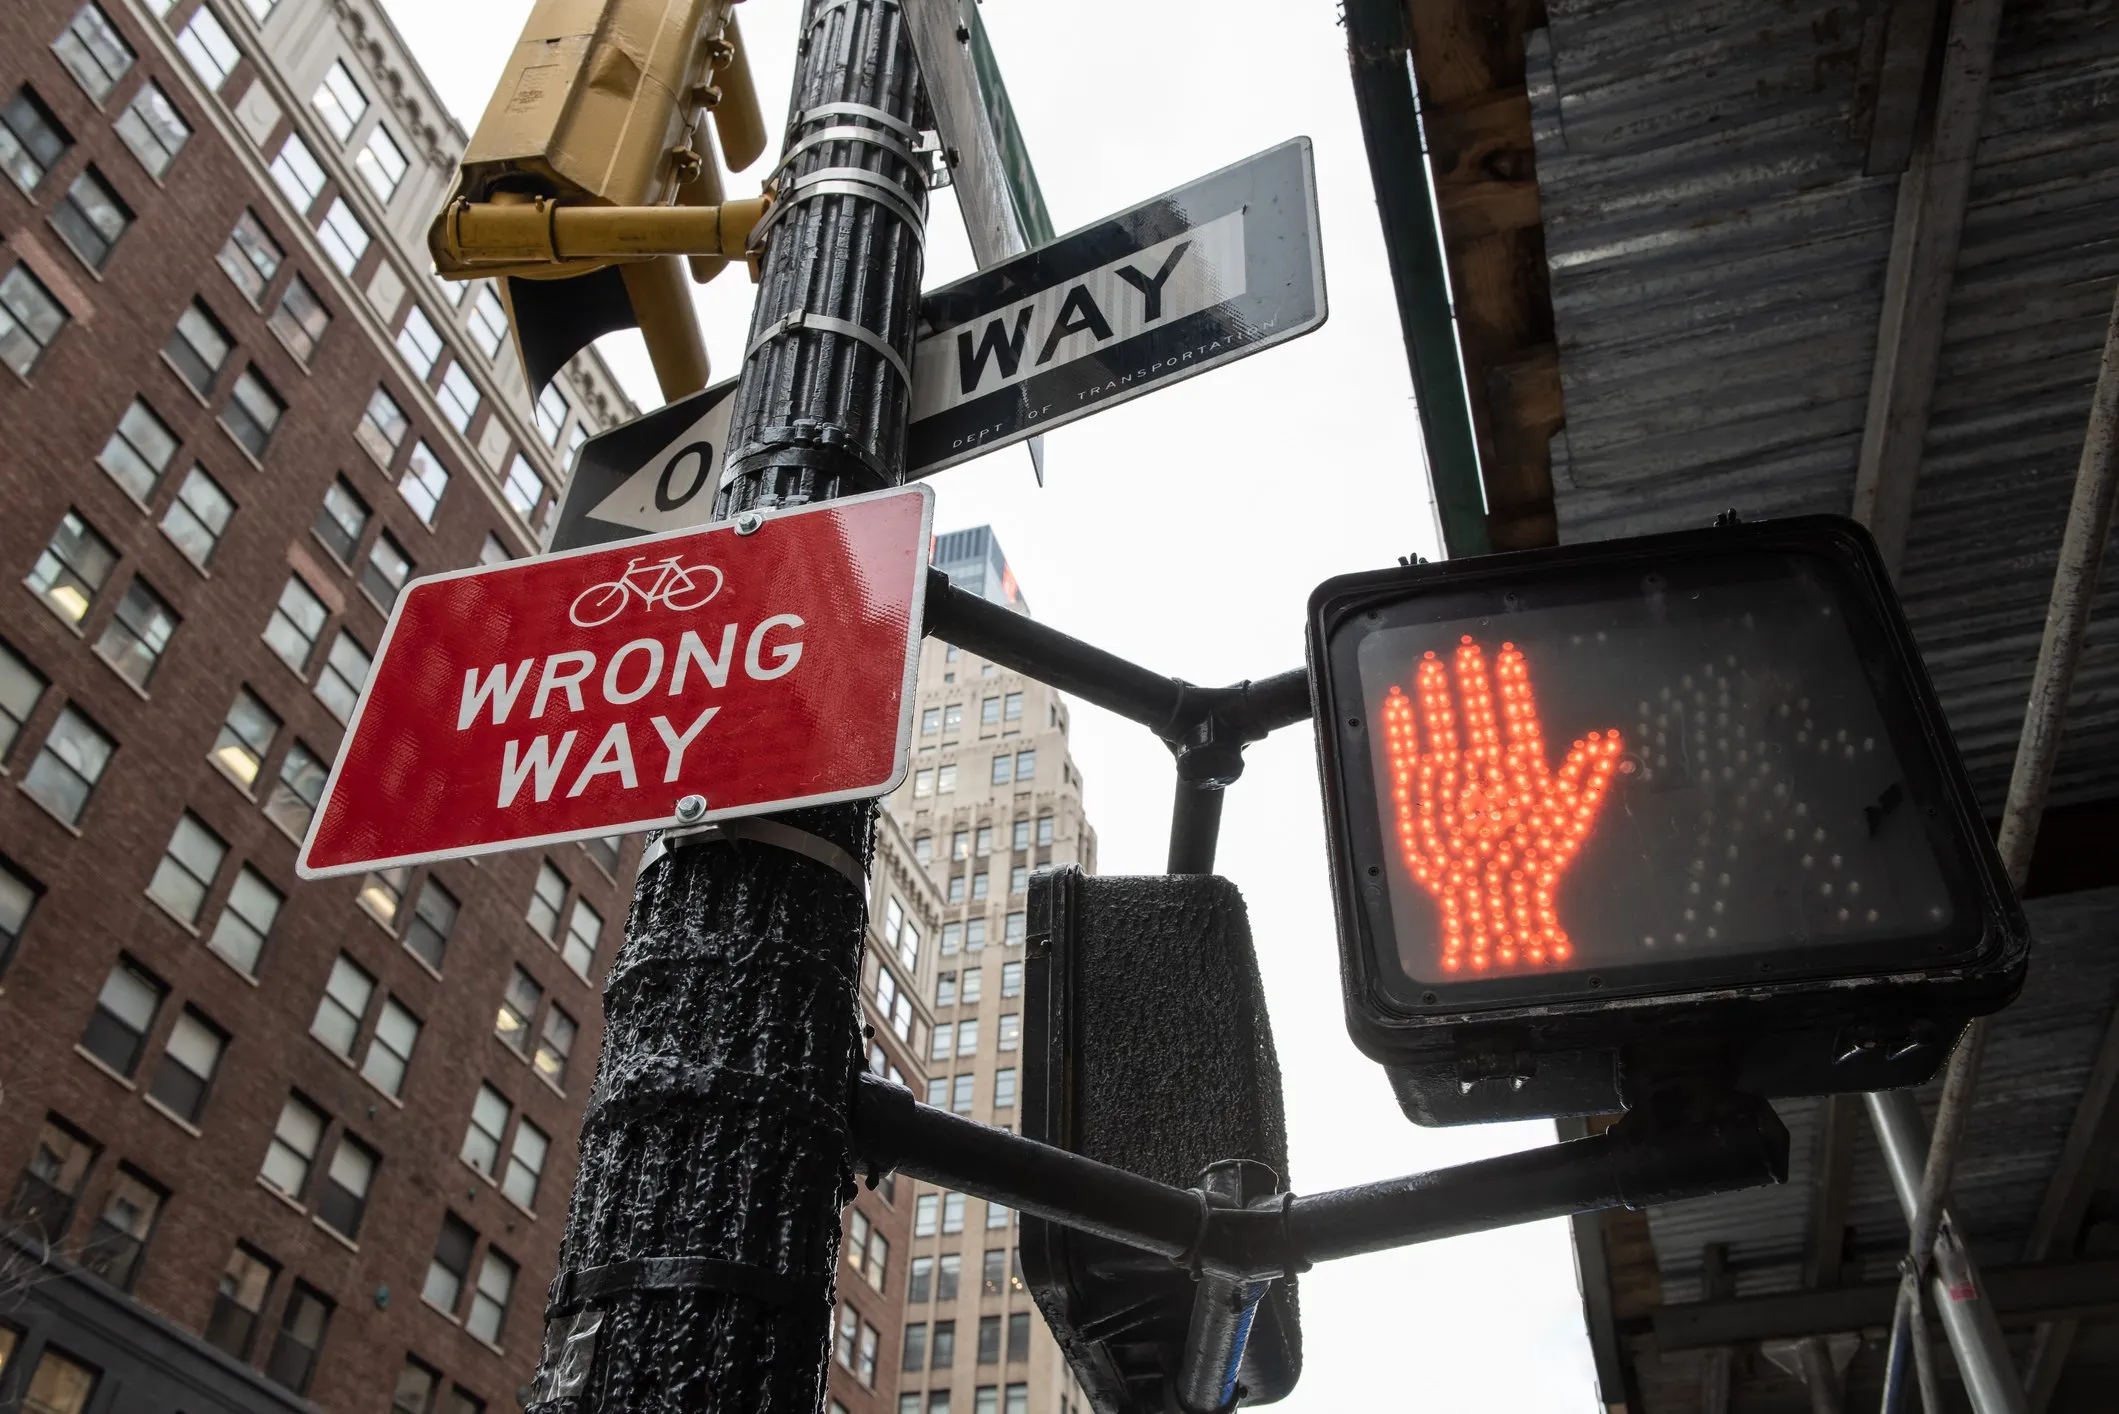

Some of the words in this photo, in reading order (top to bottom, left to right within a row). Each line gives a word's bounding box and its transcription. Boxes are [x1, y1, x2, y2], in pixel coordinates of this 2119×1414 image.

[957, 240, 1192, 395] WAY
[953, 423, 1003, 448] DEPT
[1028, 404, 1052, 419] OF
[1077, 319, 1275, 400] TRANSPORTATION
[457, 613, 806, 731] WRONG
[497, 706, 721, 808] WAY
